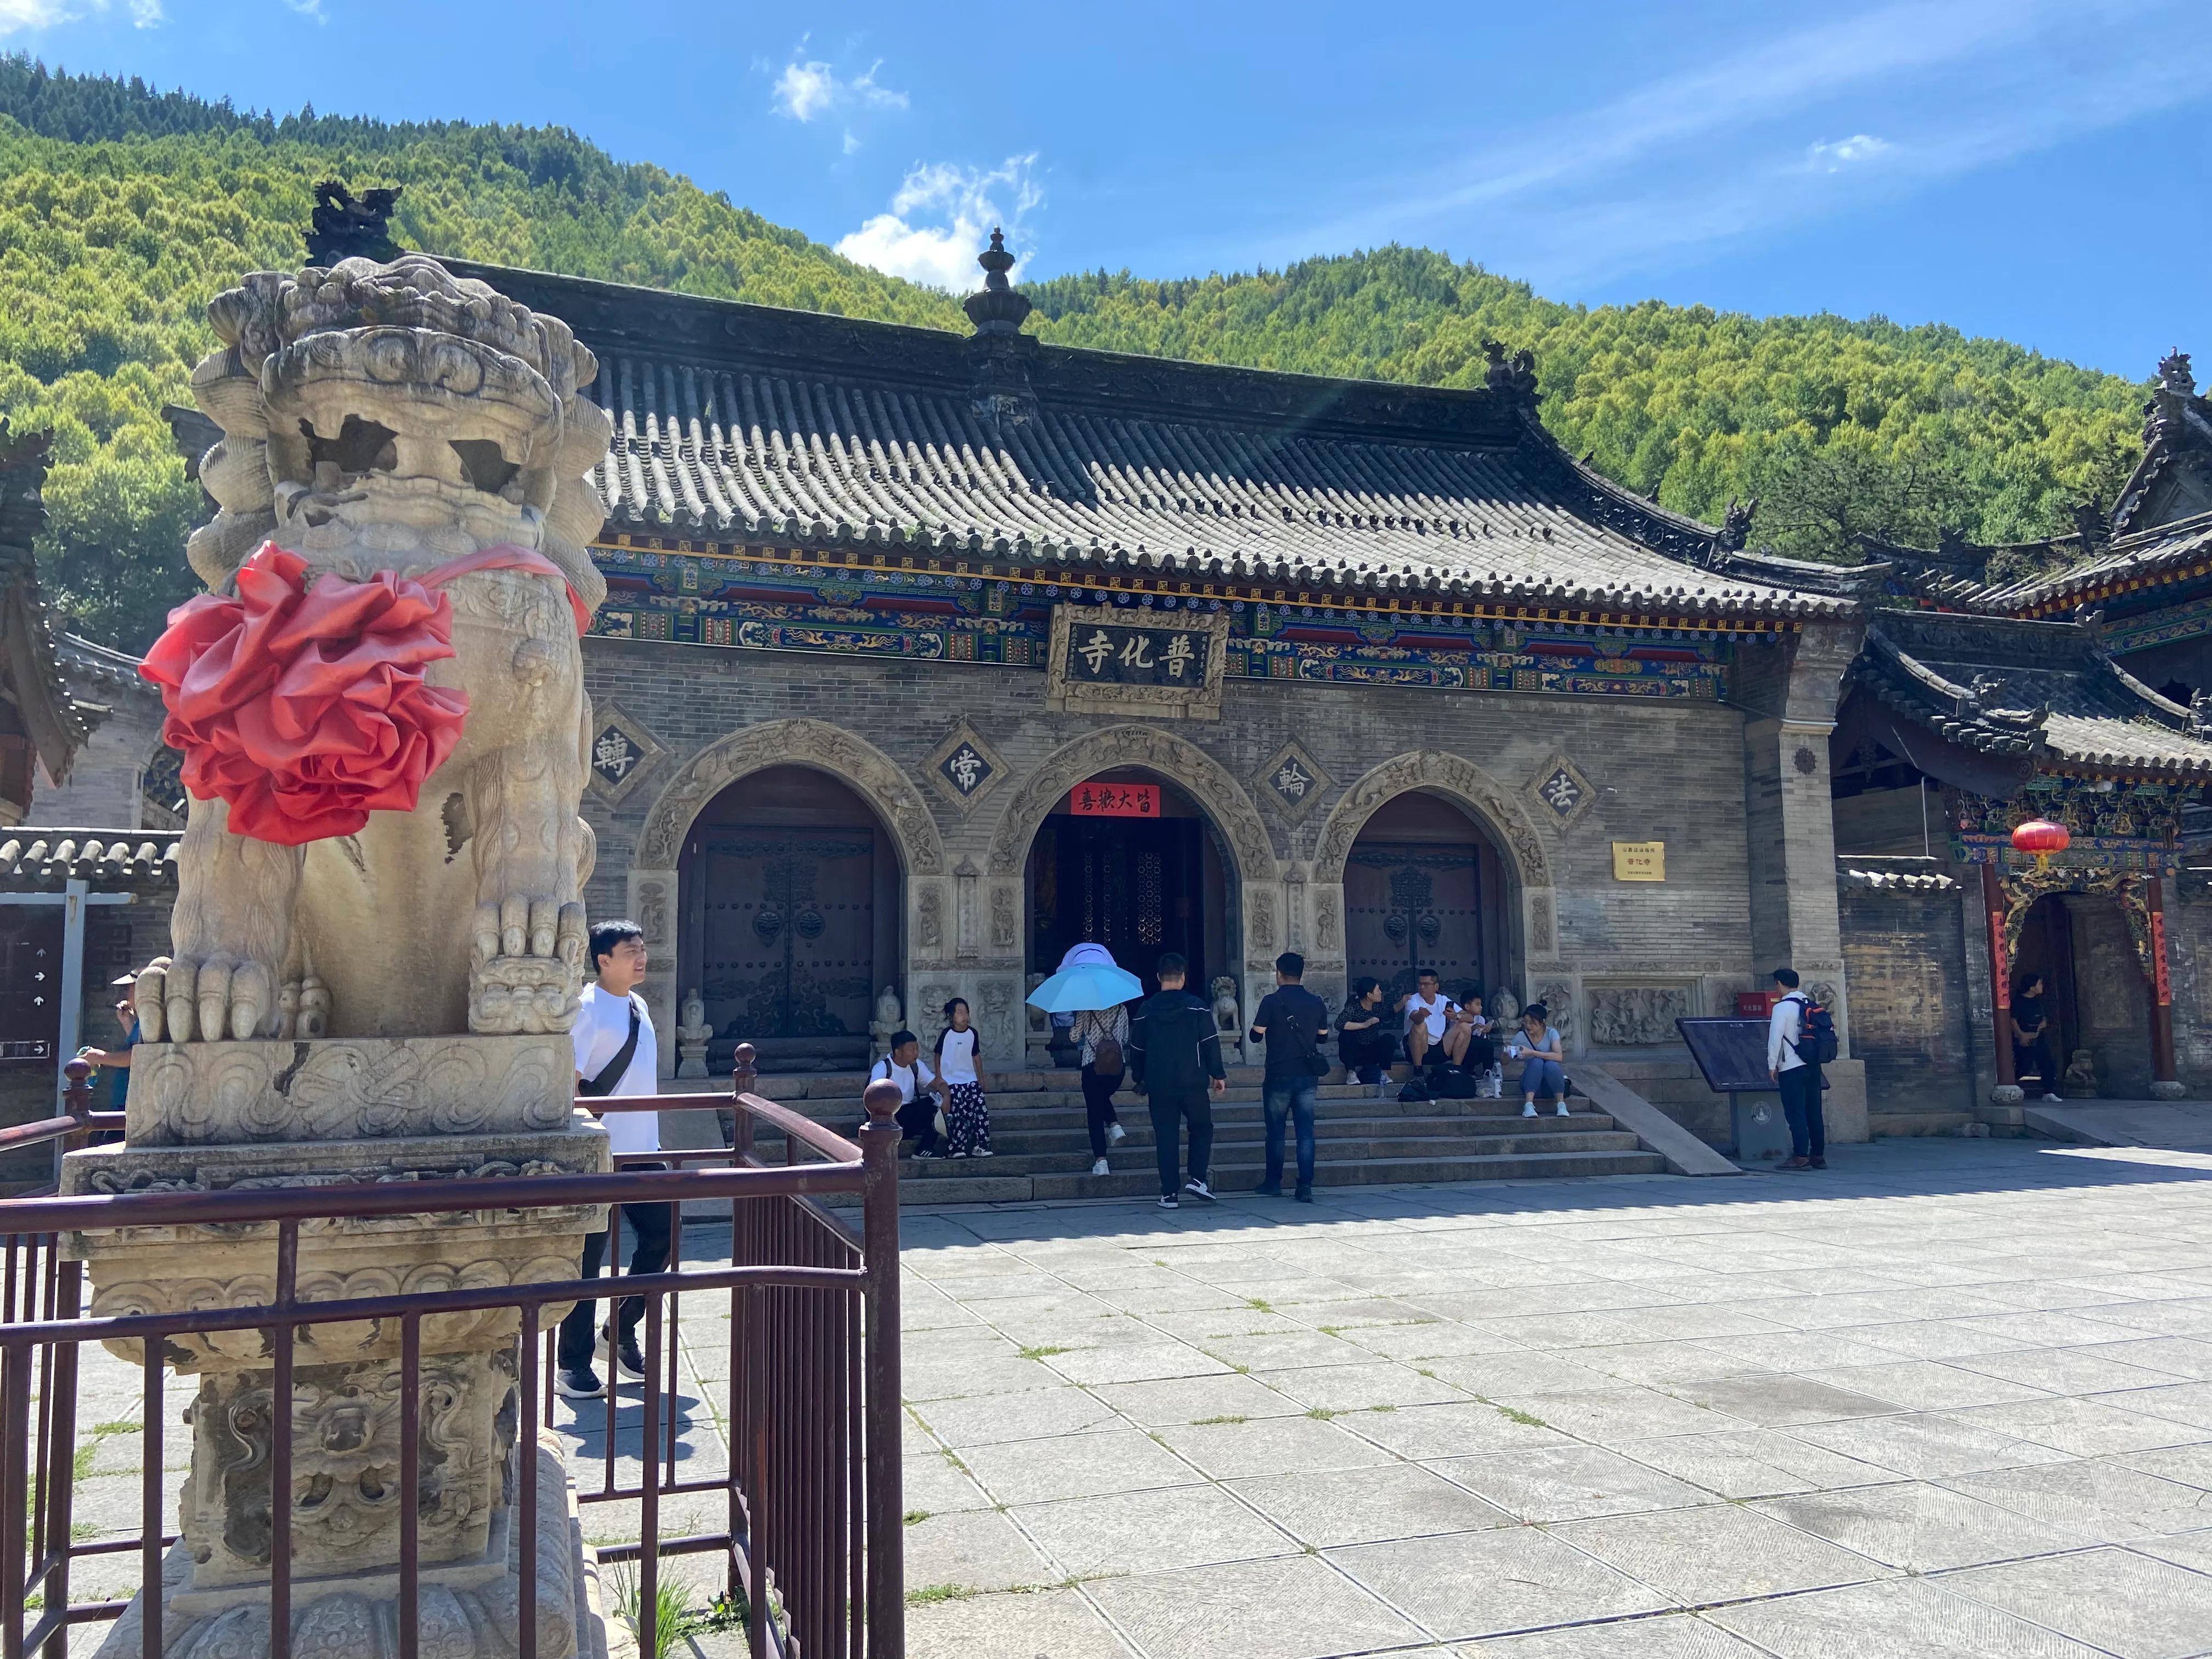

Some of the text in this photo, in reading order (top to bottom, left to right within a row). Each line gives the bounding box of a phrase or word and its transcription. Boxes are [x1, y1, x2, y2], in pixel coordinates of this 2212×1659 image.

[1078, 630, 1195, 678] 普化寺
[593, 732, 634, 777] 轉
[950, 749, 982, 792] 常
[1278, 763, 1311, 797] 輪
[1548, 774, 1578, 807] 法
